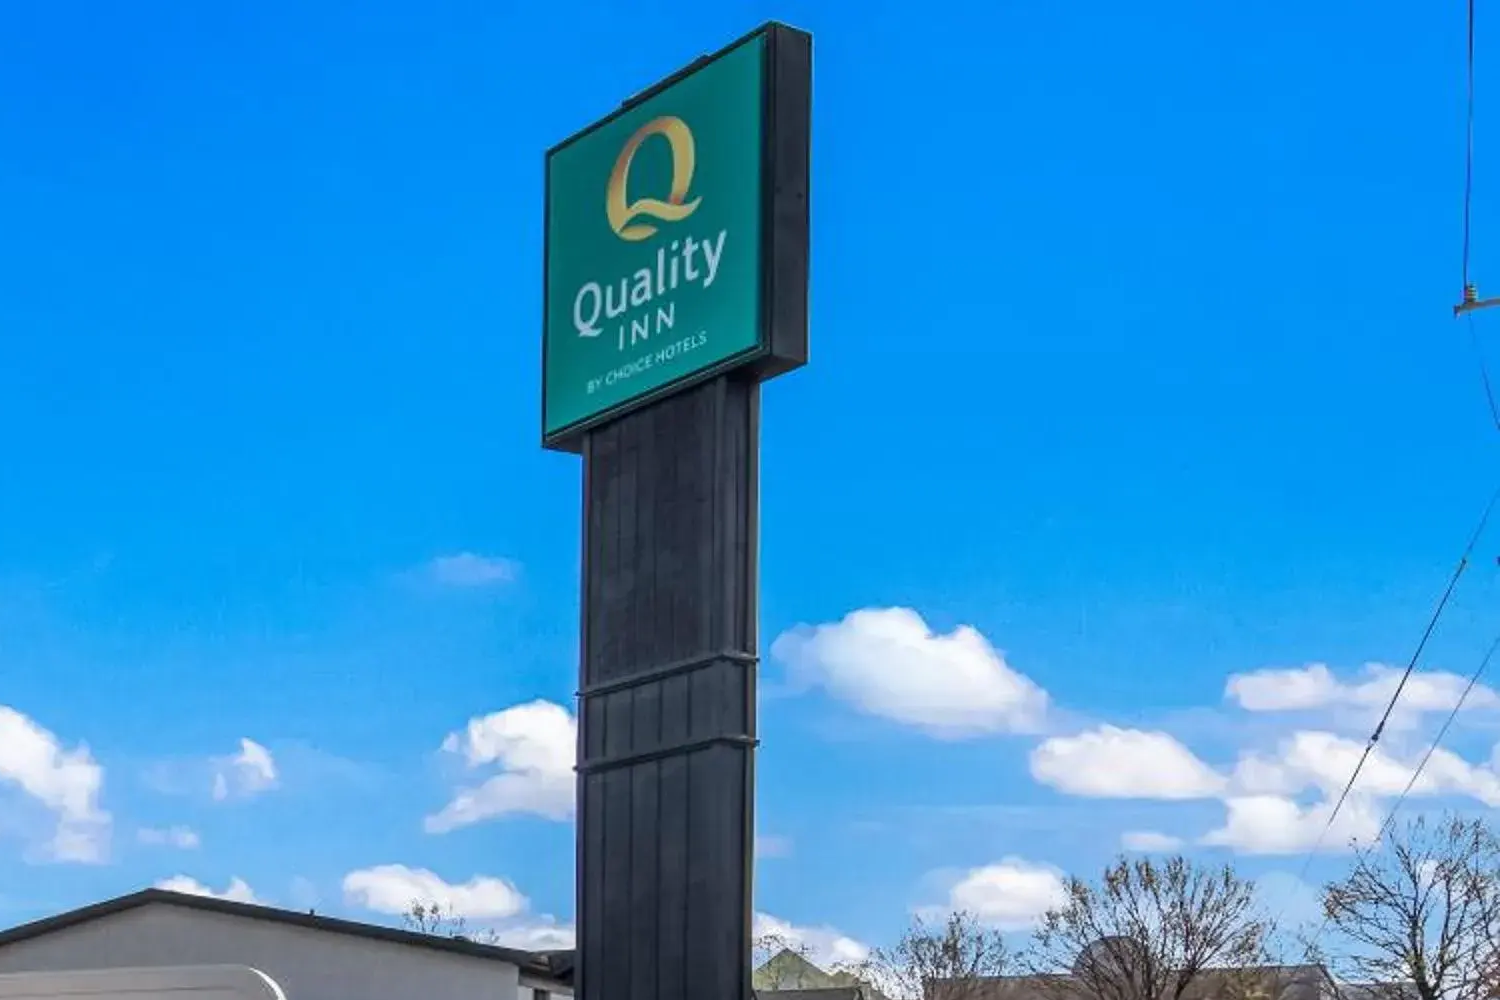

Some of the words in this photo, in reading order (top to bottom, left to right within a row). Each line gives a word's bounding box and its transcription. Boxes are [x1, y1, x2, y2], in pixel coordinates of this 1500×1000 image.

[606, 116, 703, 241] Q
[573, 229, 727, 337] Quality
[586, 376, 603, 395] BY
[605, 353, 653, 386] CHOICE
[654, 329, 707, 363] HOTELS
[618, 303, 675, 351] INN
